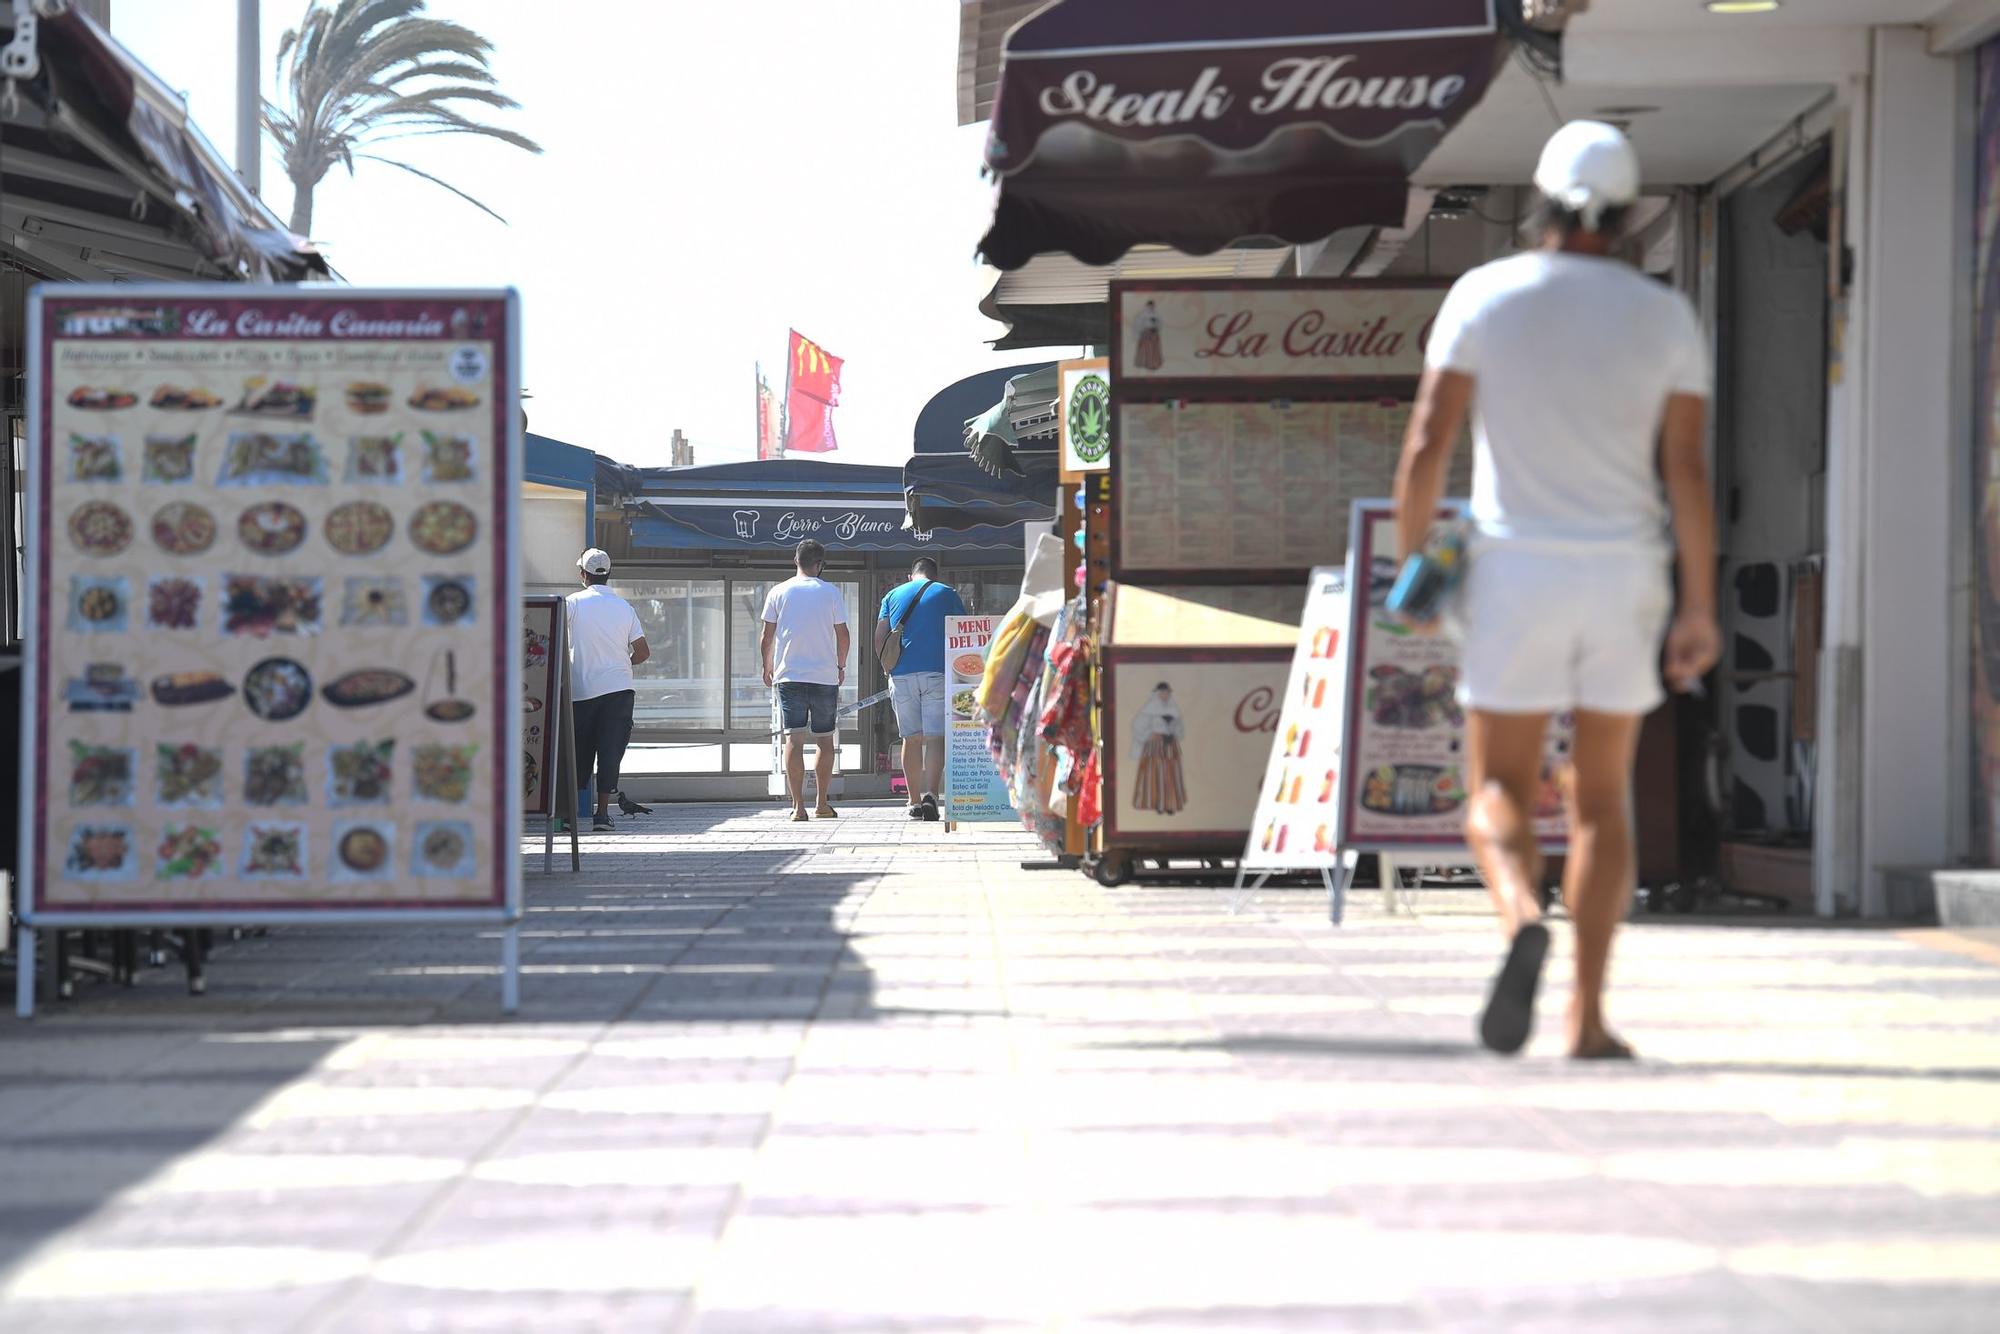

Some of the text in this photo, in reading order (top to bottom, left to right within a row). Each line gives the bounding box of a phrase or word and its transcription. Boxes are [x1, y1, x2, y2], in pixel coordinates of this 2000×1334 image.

[1039, 54, 1465, 126] Steak House
[184, 307, 229, 337] La
[235, 307, 323, 337] Casita
[1194, 309, 1269, 359] La
[1281, 309, 1405, 358] Casita
[773, 511, 894, 540] Gorro Blanco
[957, 617, 991, 633] MENÚ
[949, 636, 973, 649] DEL
